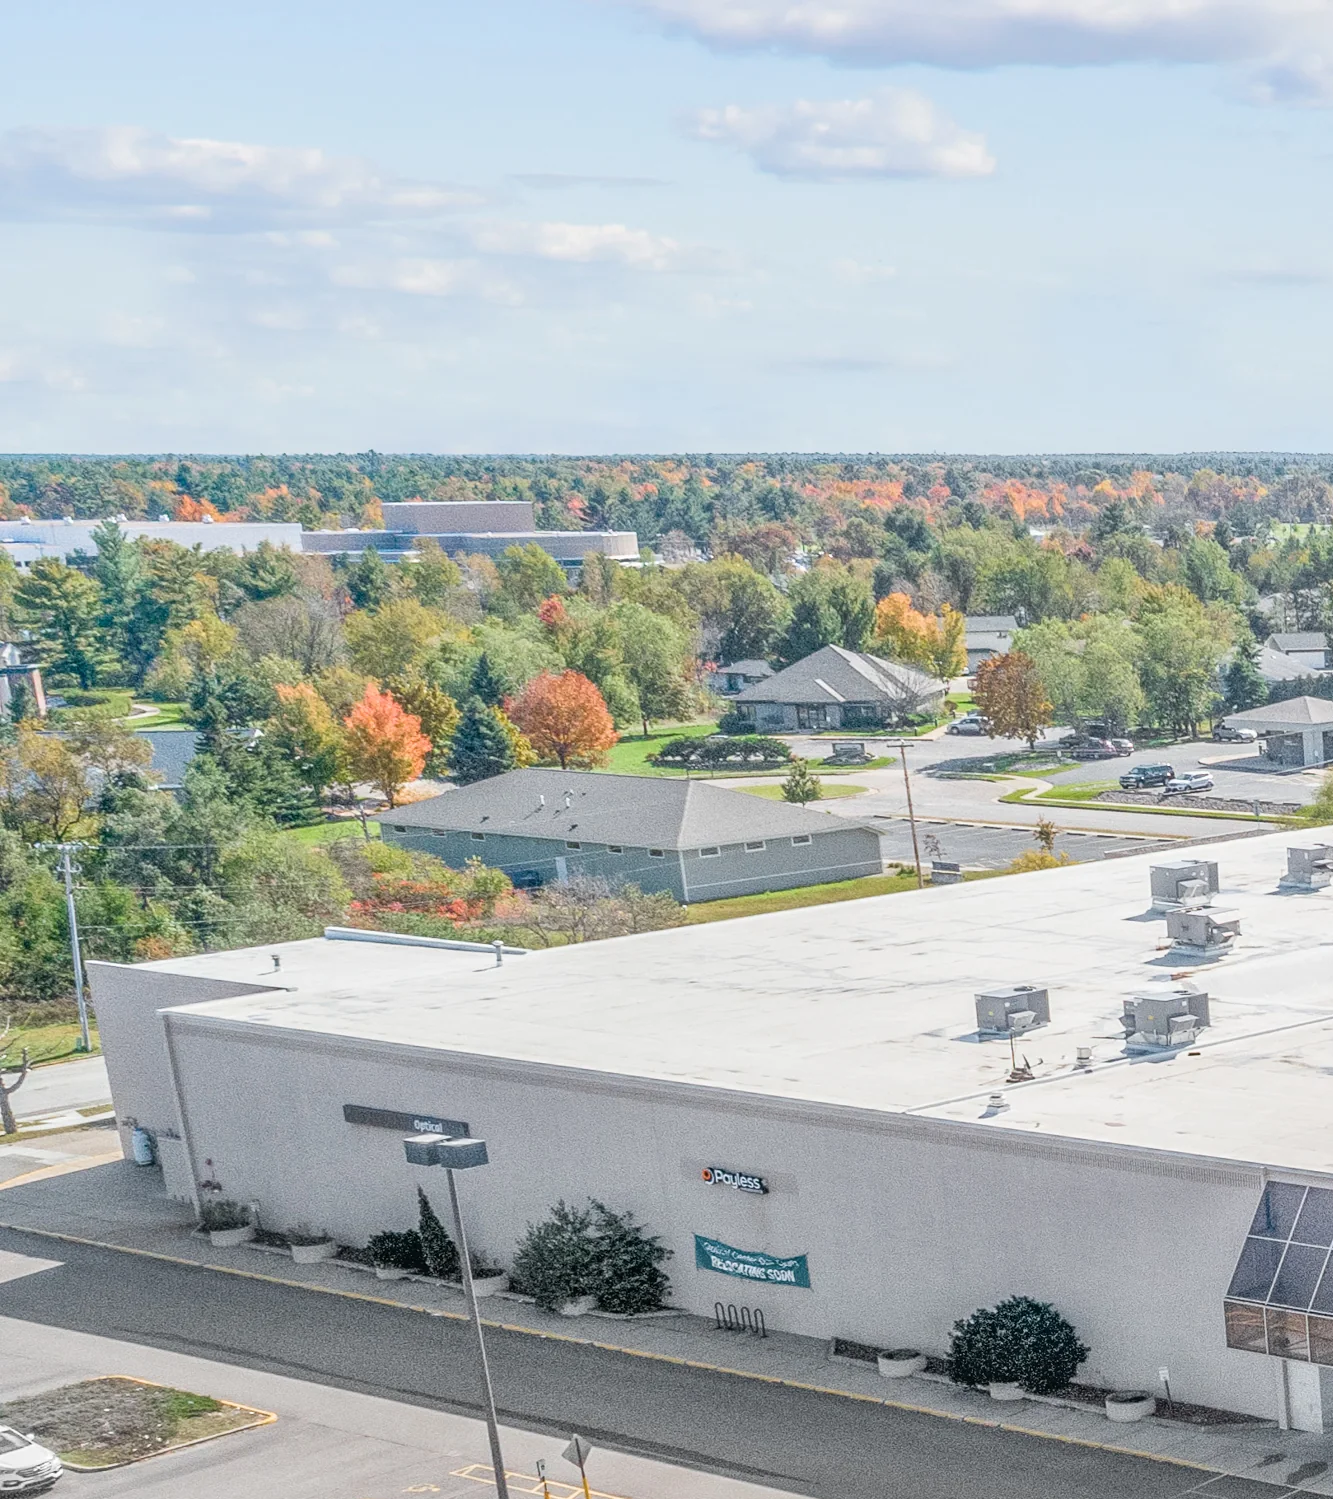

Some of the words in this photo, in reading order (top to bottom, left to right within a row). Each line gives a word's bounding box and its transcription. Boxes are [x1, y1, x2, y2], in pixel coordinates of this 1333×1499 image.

[414, 1119, 443, 1132] Optical
[714, 1169, 760, 1189] Payless
[711, 1255, 766, 1279] RELOCATING
[766, 1269, 795, 1282] SOON
